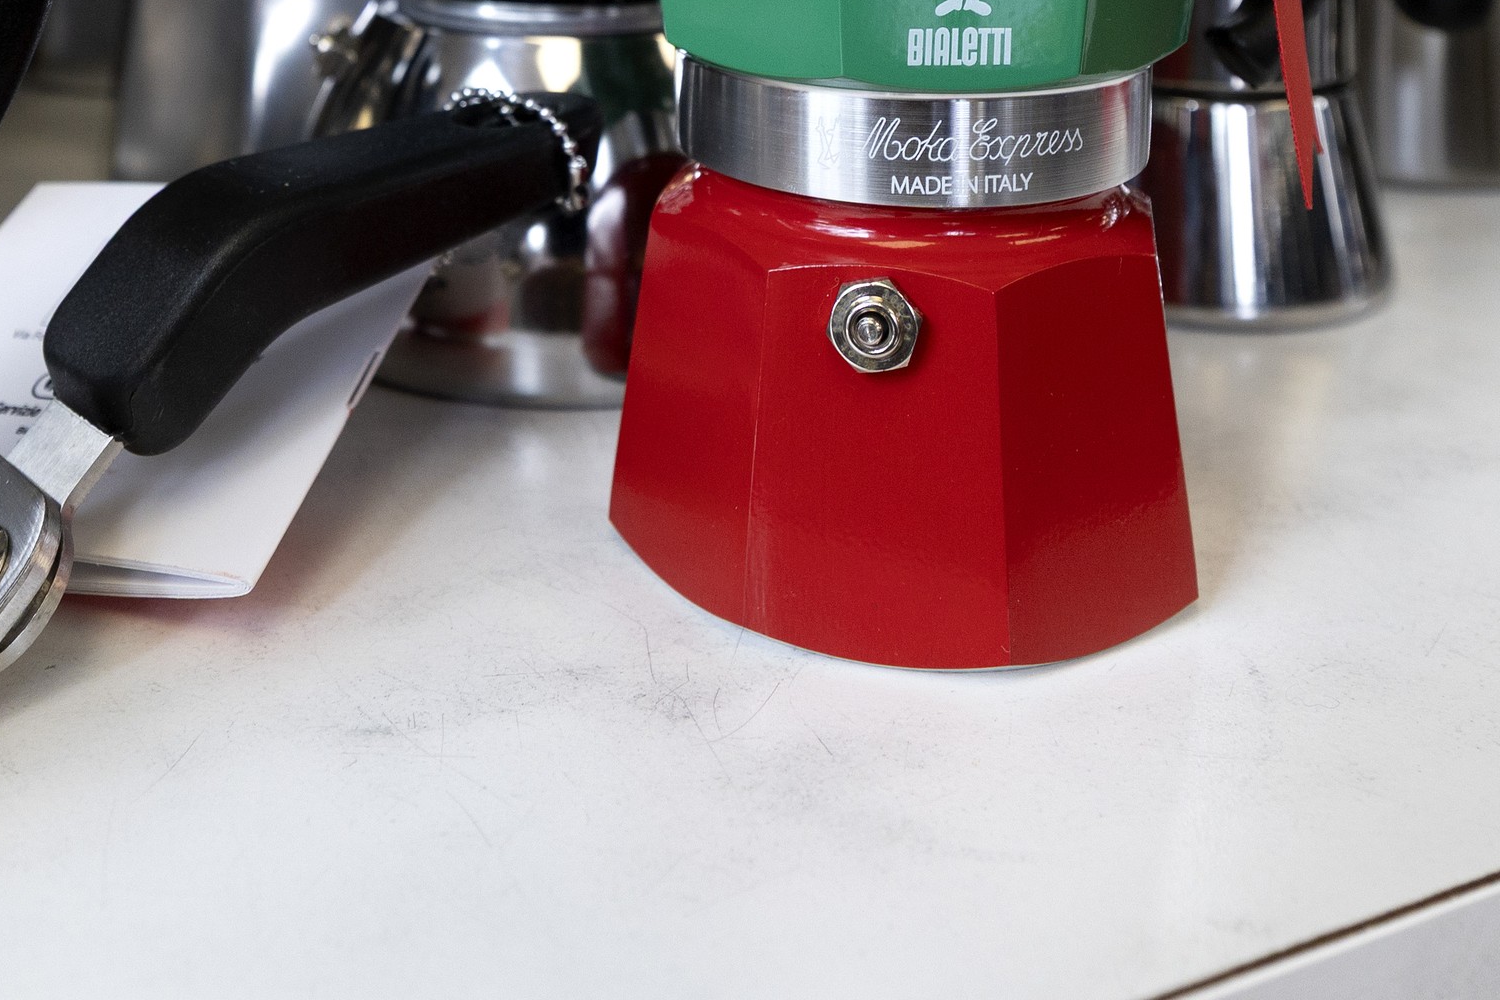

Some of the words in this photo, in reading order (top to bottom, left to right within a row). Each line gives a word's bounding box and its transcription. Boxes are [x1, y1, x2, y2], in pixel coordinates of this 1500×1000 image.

[862, 116, 961, 161] Moka
[969, 117, 1084, 166] Express
[891, 175, 952, 195] MADE
[957, 175, 978, 195] IN
[984, 172, 1033, 194] ITALY
